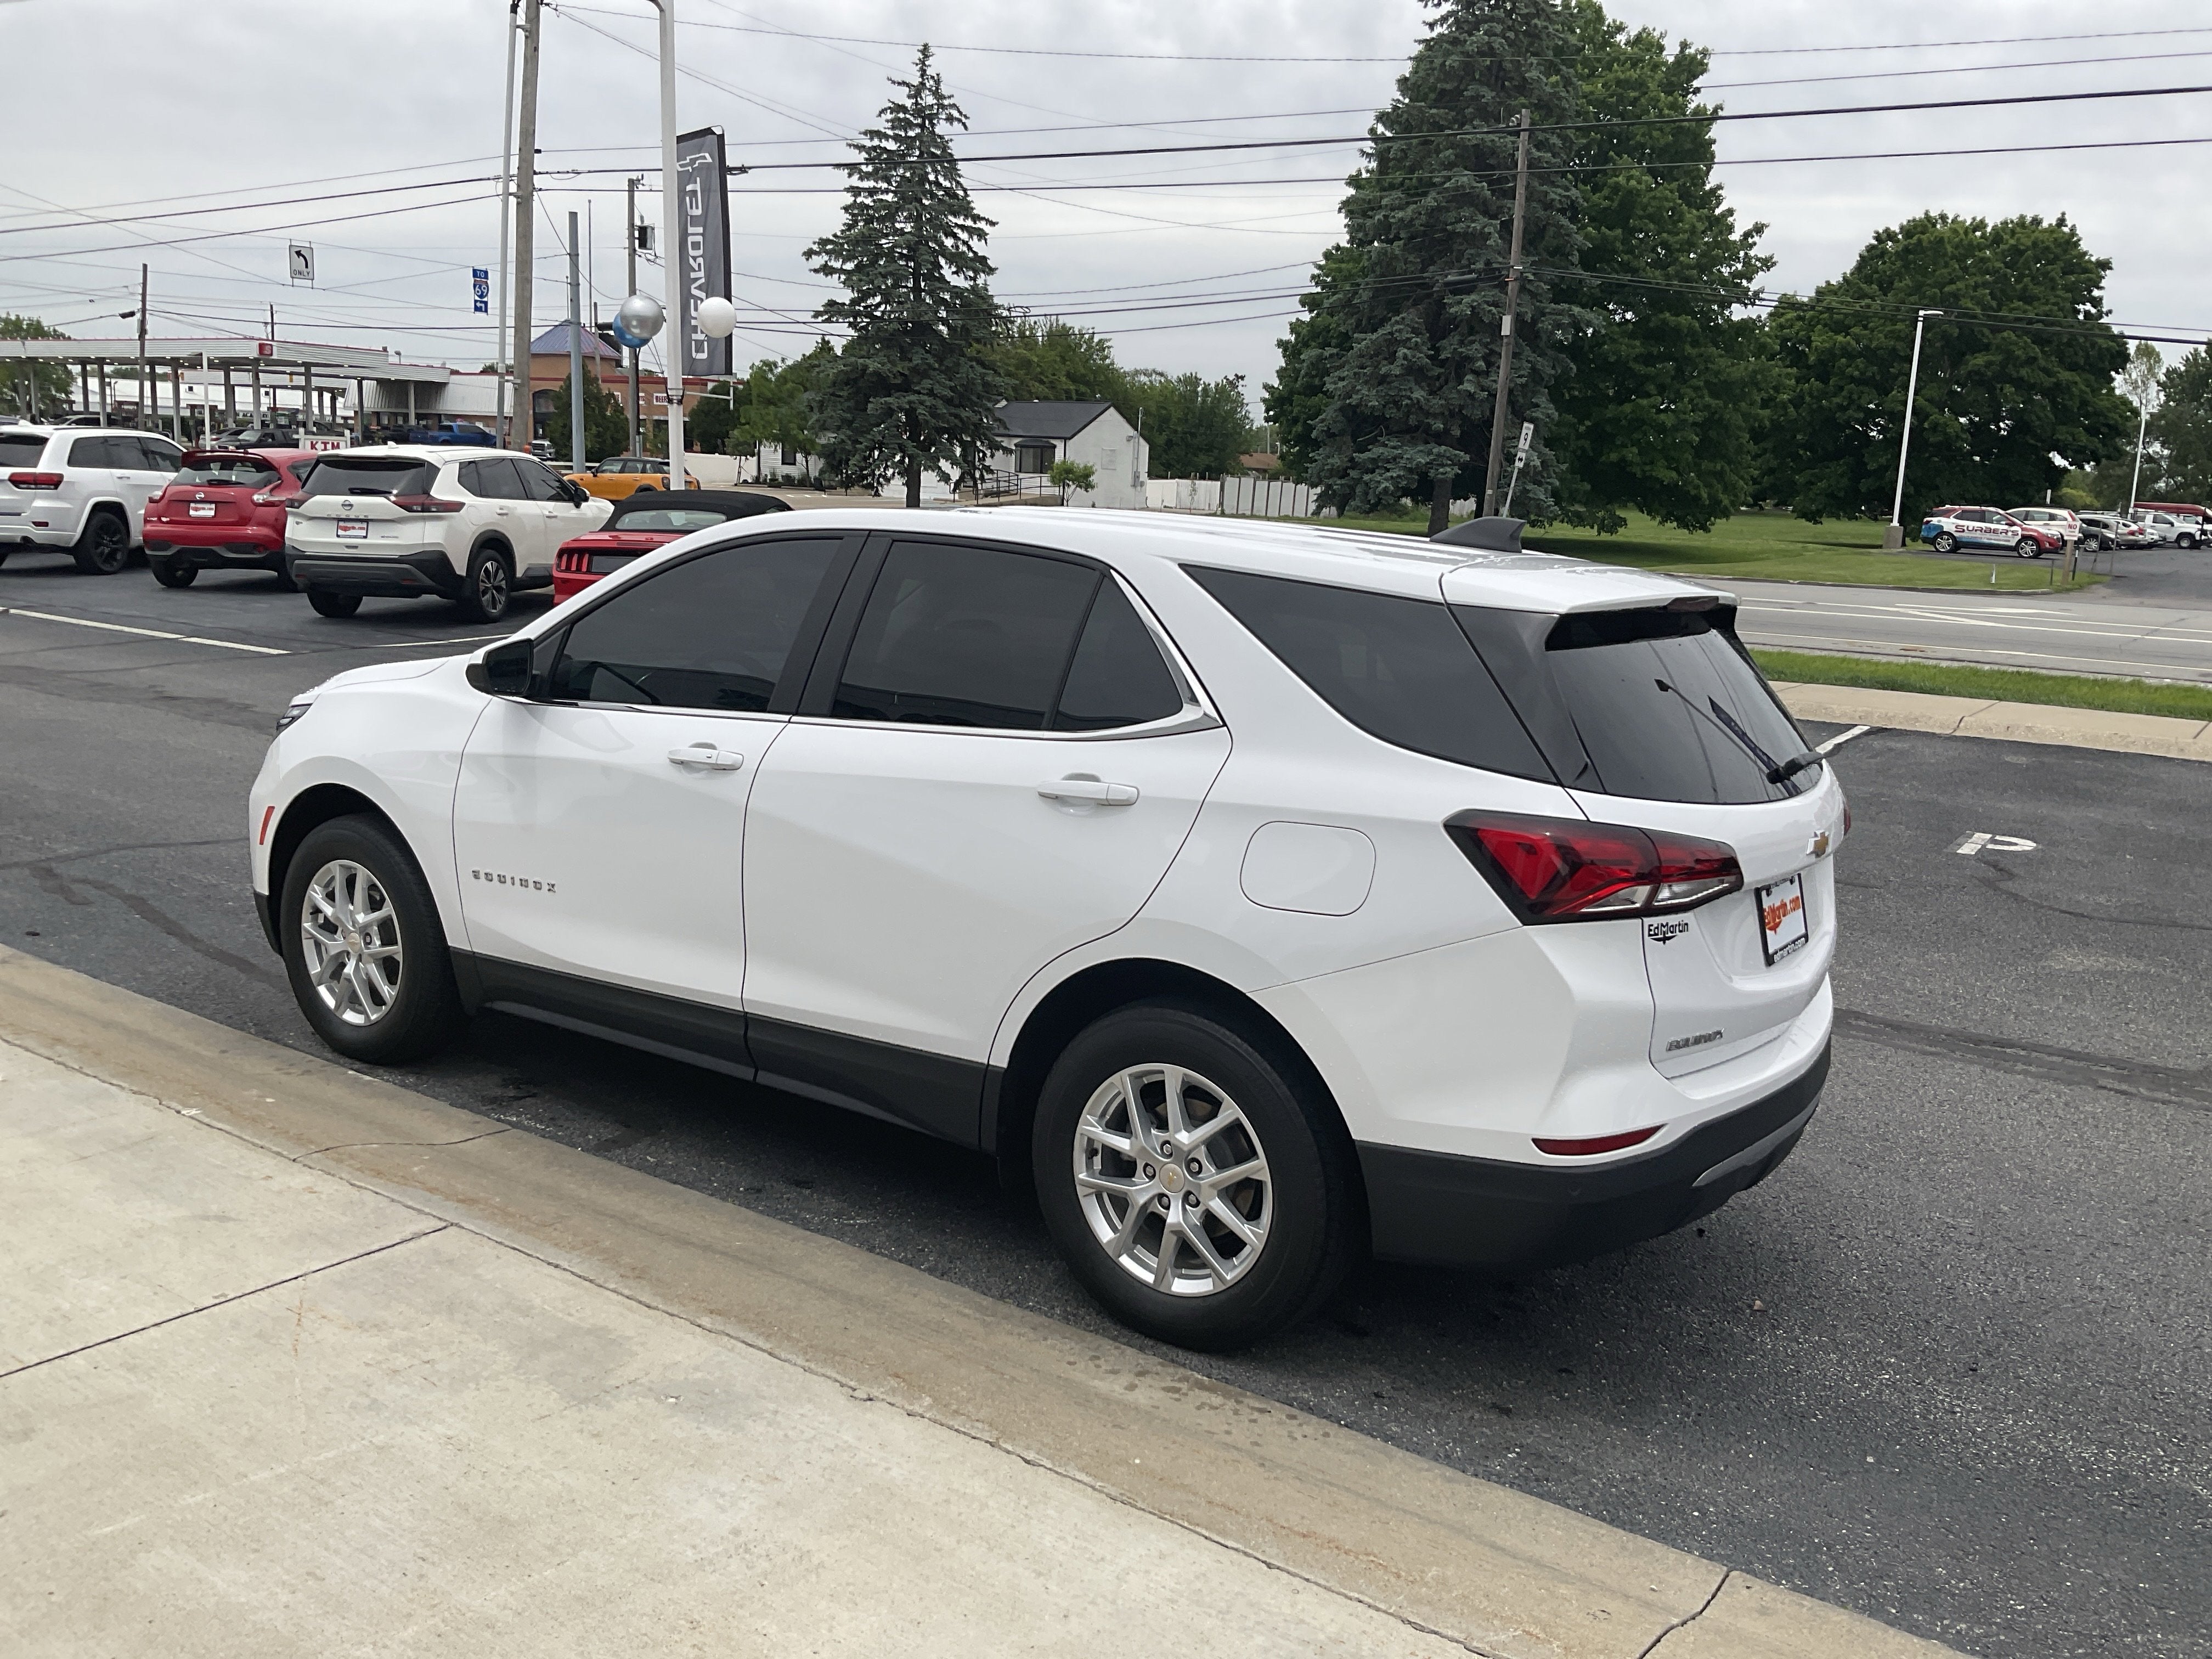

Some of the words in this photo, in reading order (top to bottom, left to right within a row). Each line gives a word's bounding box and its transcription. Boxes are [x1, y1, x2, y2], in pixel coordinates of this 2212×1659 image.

[293, 269, 310, 277] ONLY
[475, 285, 487, 296] 69
[310, 441, 340, 451] KIM
[472, 869, 556, 893] EQUINOX
[1774, 937, 1805, 963] edmartin.com
